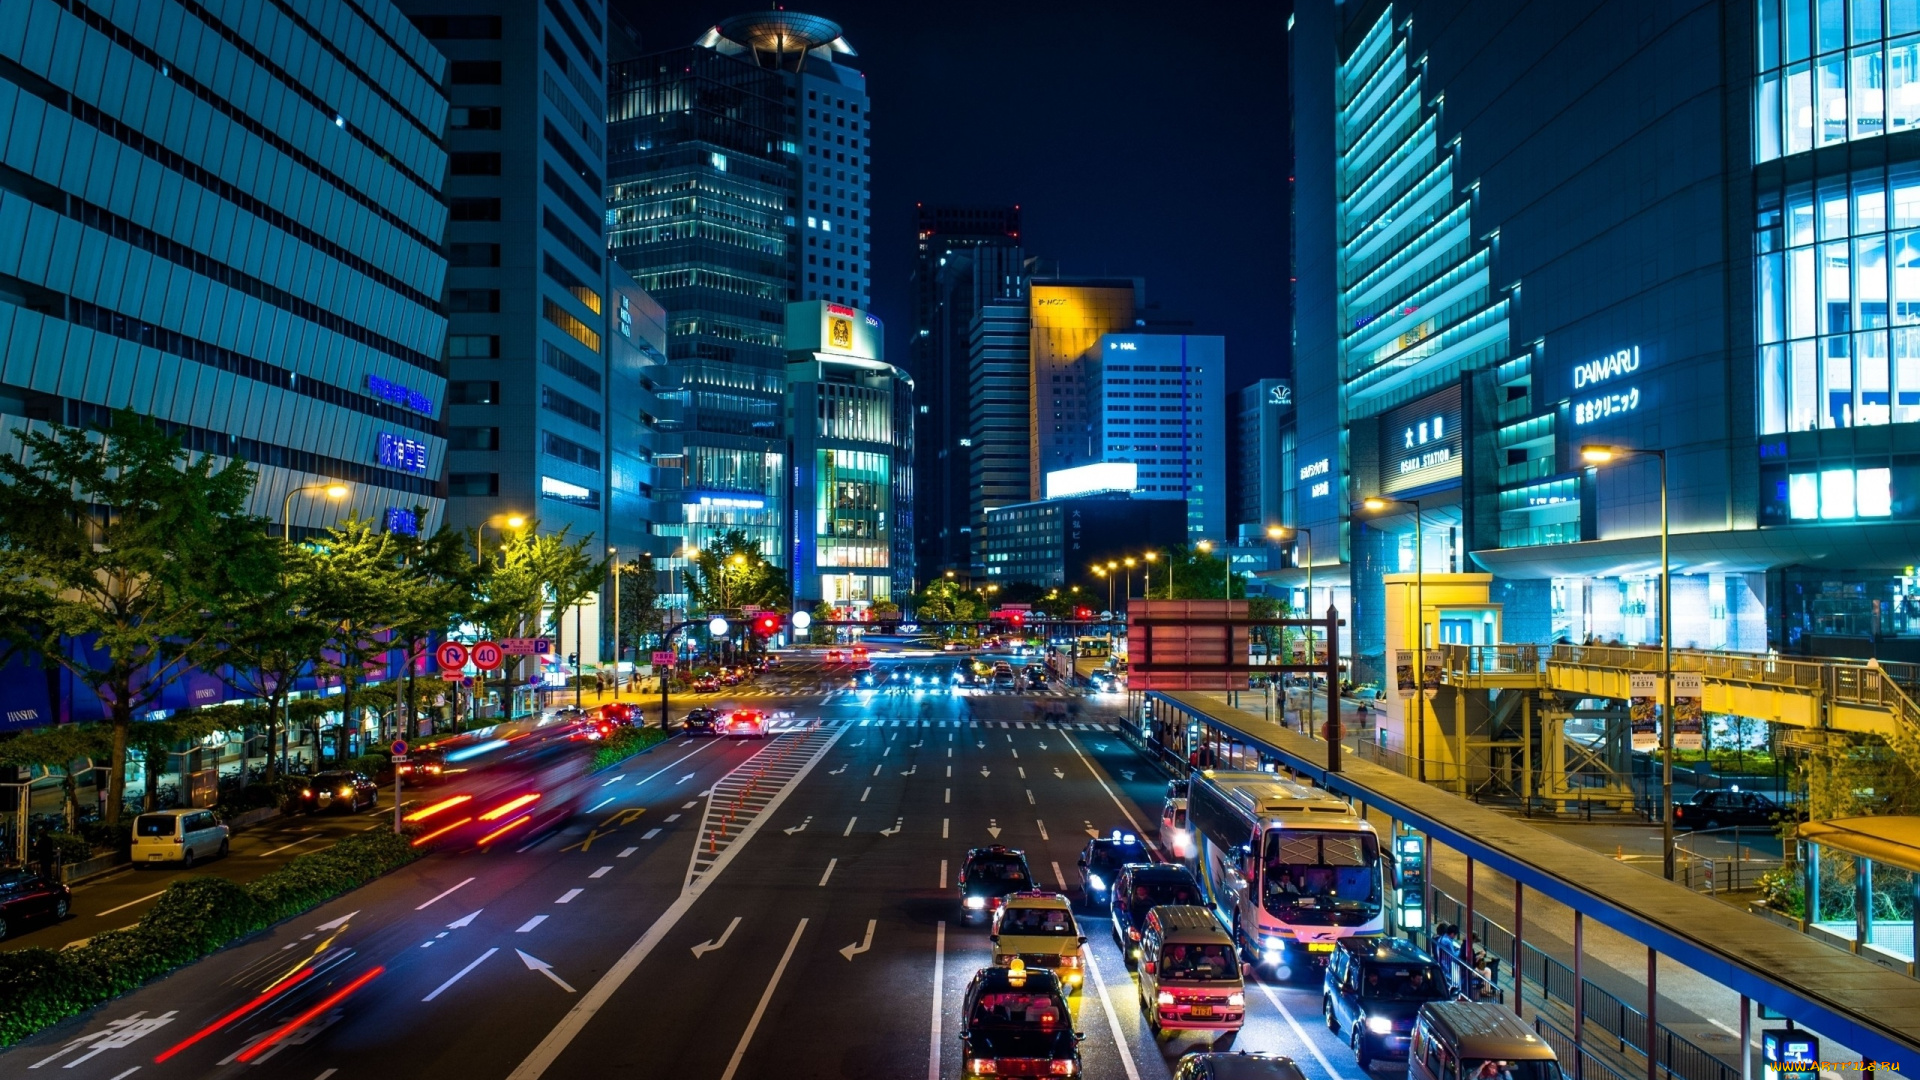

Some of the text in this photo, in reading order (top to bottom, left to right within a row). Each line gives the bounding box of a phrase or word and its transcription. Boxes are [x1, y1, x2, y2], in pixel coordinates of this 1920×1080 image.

[1120, 342, 1137, 351] HAL
[1574, 345, 1640, 389] DAIMARU
[1575, 387, 1639, 426] 総合クリニック
[380, 431, 426, 474] 阪神電車
[1400, 448, 1449, 474] OSAKA STATION
[1072, 509, 1081, 550] 大弘ビル
[478, 649, 496, 662] 40
[537, 642, 545, 652] P
[195, 688, 216, 699] HANSHIN
[7, 709, 39, 722] HANSHIN
[27, 1010, 180, 1069] 神
